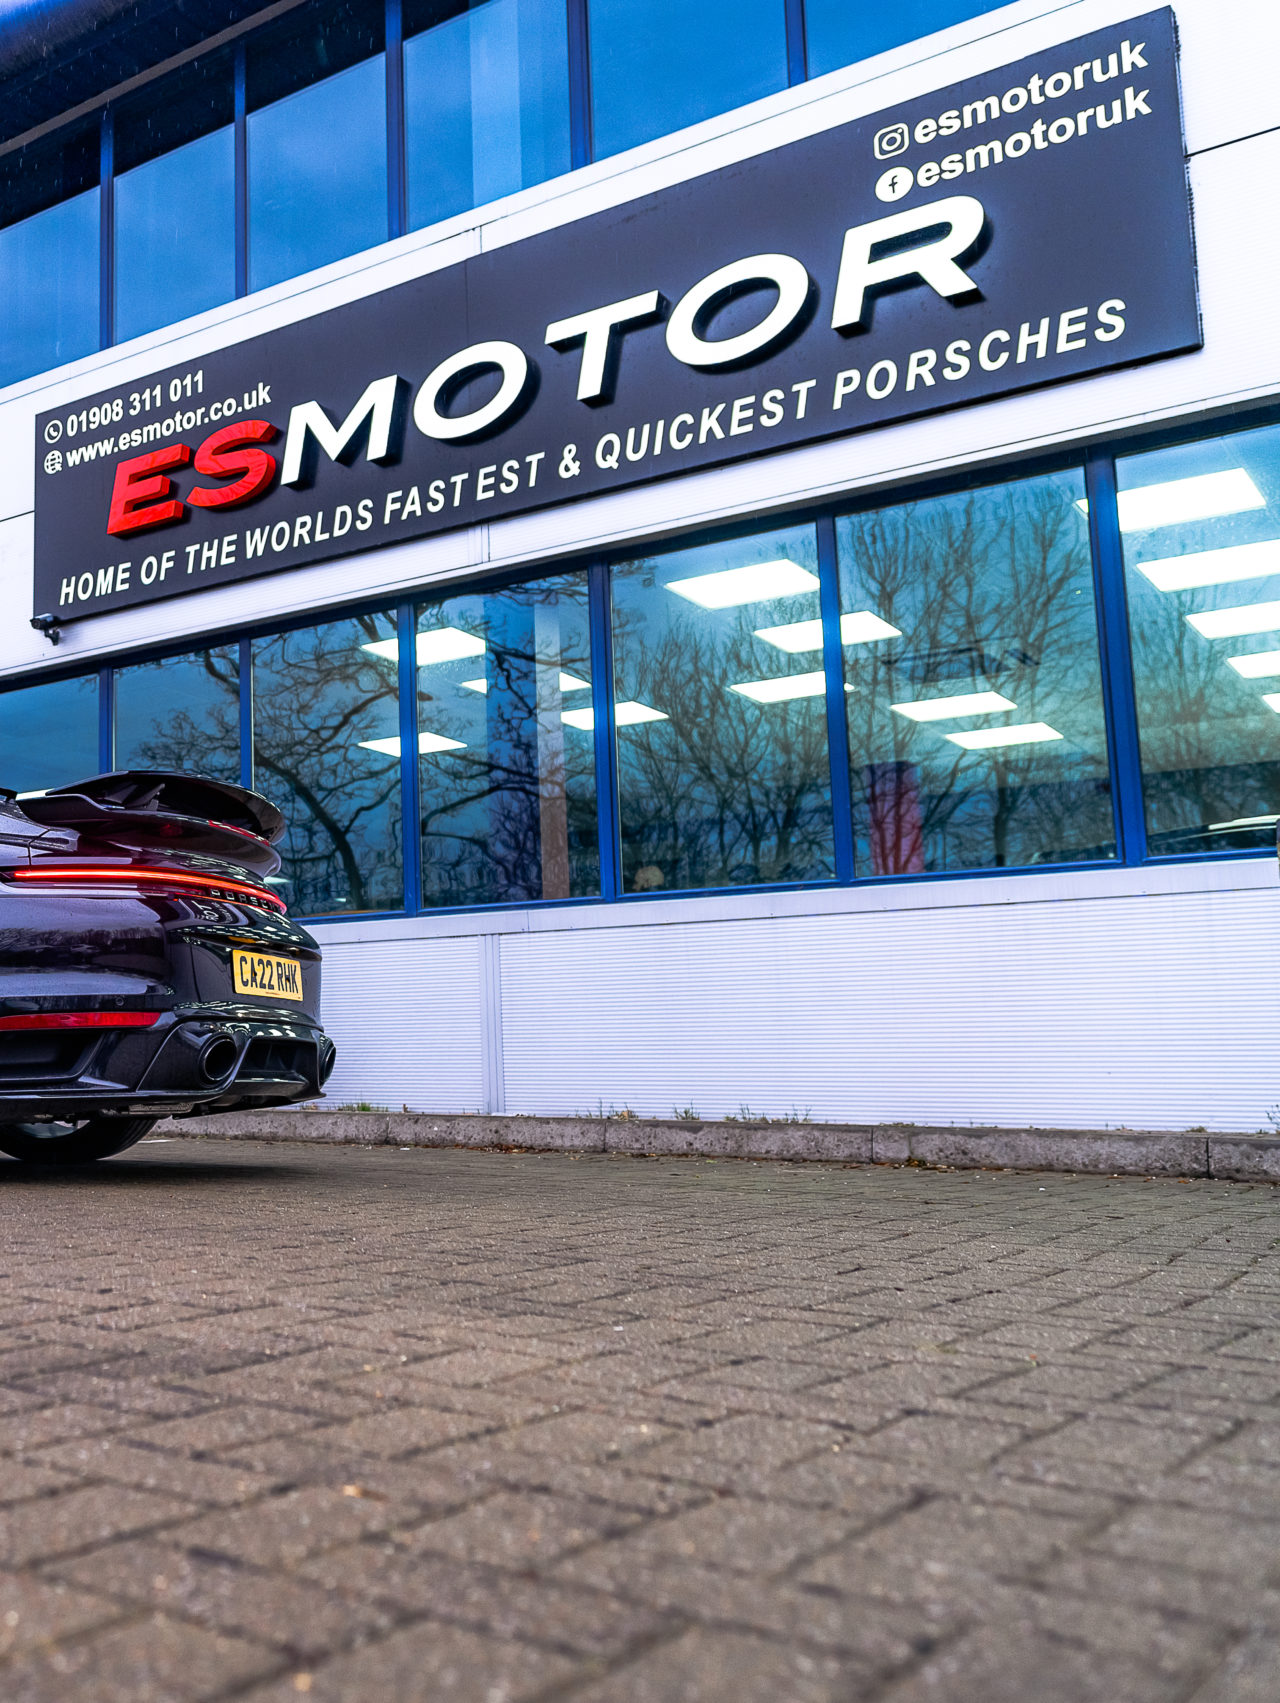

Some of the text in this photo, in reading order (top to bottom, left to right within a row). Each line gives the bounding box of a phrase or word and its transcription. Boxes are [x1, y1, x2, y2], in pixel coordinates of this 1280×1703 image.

[913, 39, 1149, 144] esmotoruk
[916, 86, 1153, 188] esmotoruk
[65, 382, 272, 468] www.esmotor.co.uk
[66, 369, 203, 437] 01908 311 011
[59, 298, 1126, 606] HOME OF THE WORLDS FASTEST & QUICKEST PORSCHES
[239, 955, 299, 994] CA22 RHK
